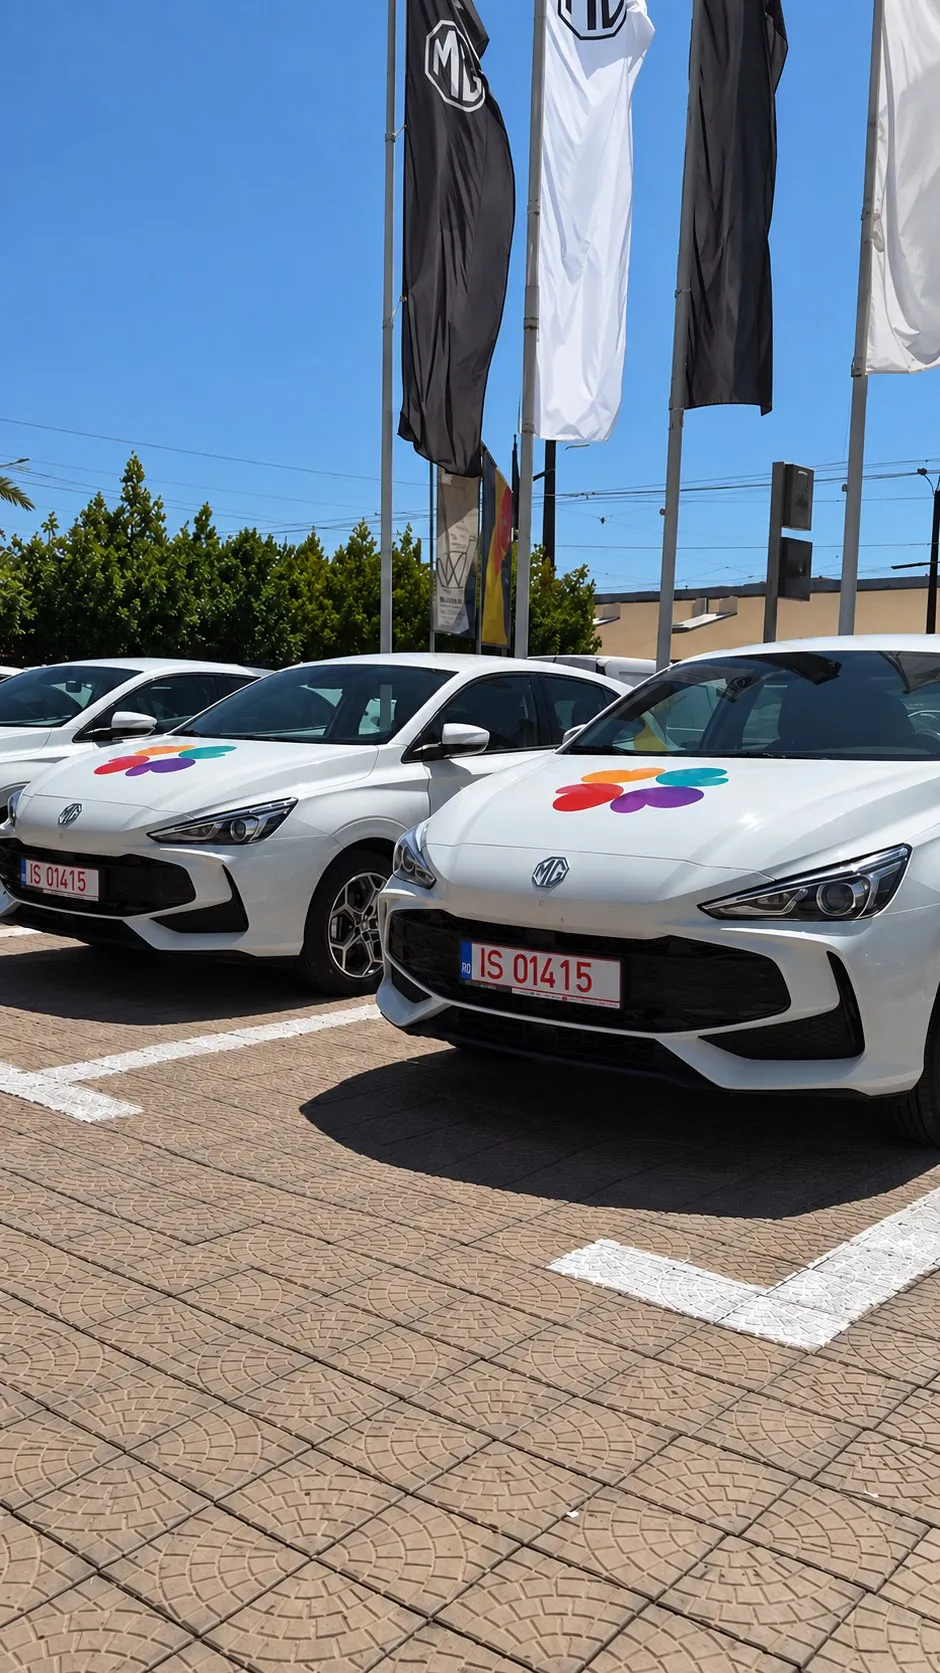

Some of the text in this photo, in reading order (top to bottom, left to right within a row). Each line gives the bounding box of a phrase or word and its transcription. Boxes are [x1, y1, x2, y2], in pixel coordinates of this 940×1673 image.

[432, 30, 483, 103] MG
[30, 863, 86, 892] IS 01415
[535, 859, 567, 886] MG
[461, 962, 472, 975] RO
[480, 948, 593, 993] IS 01415
